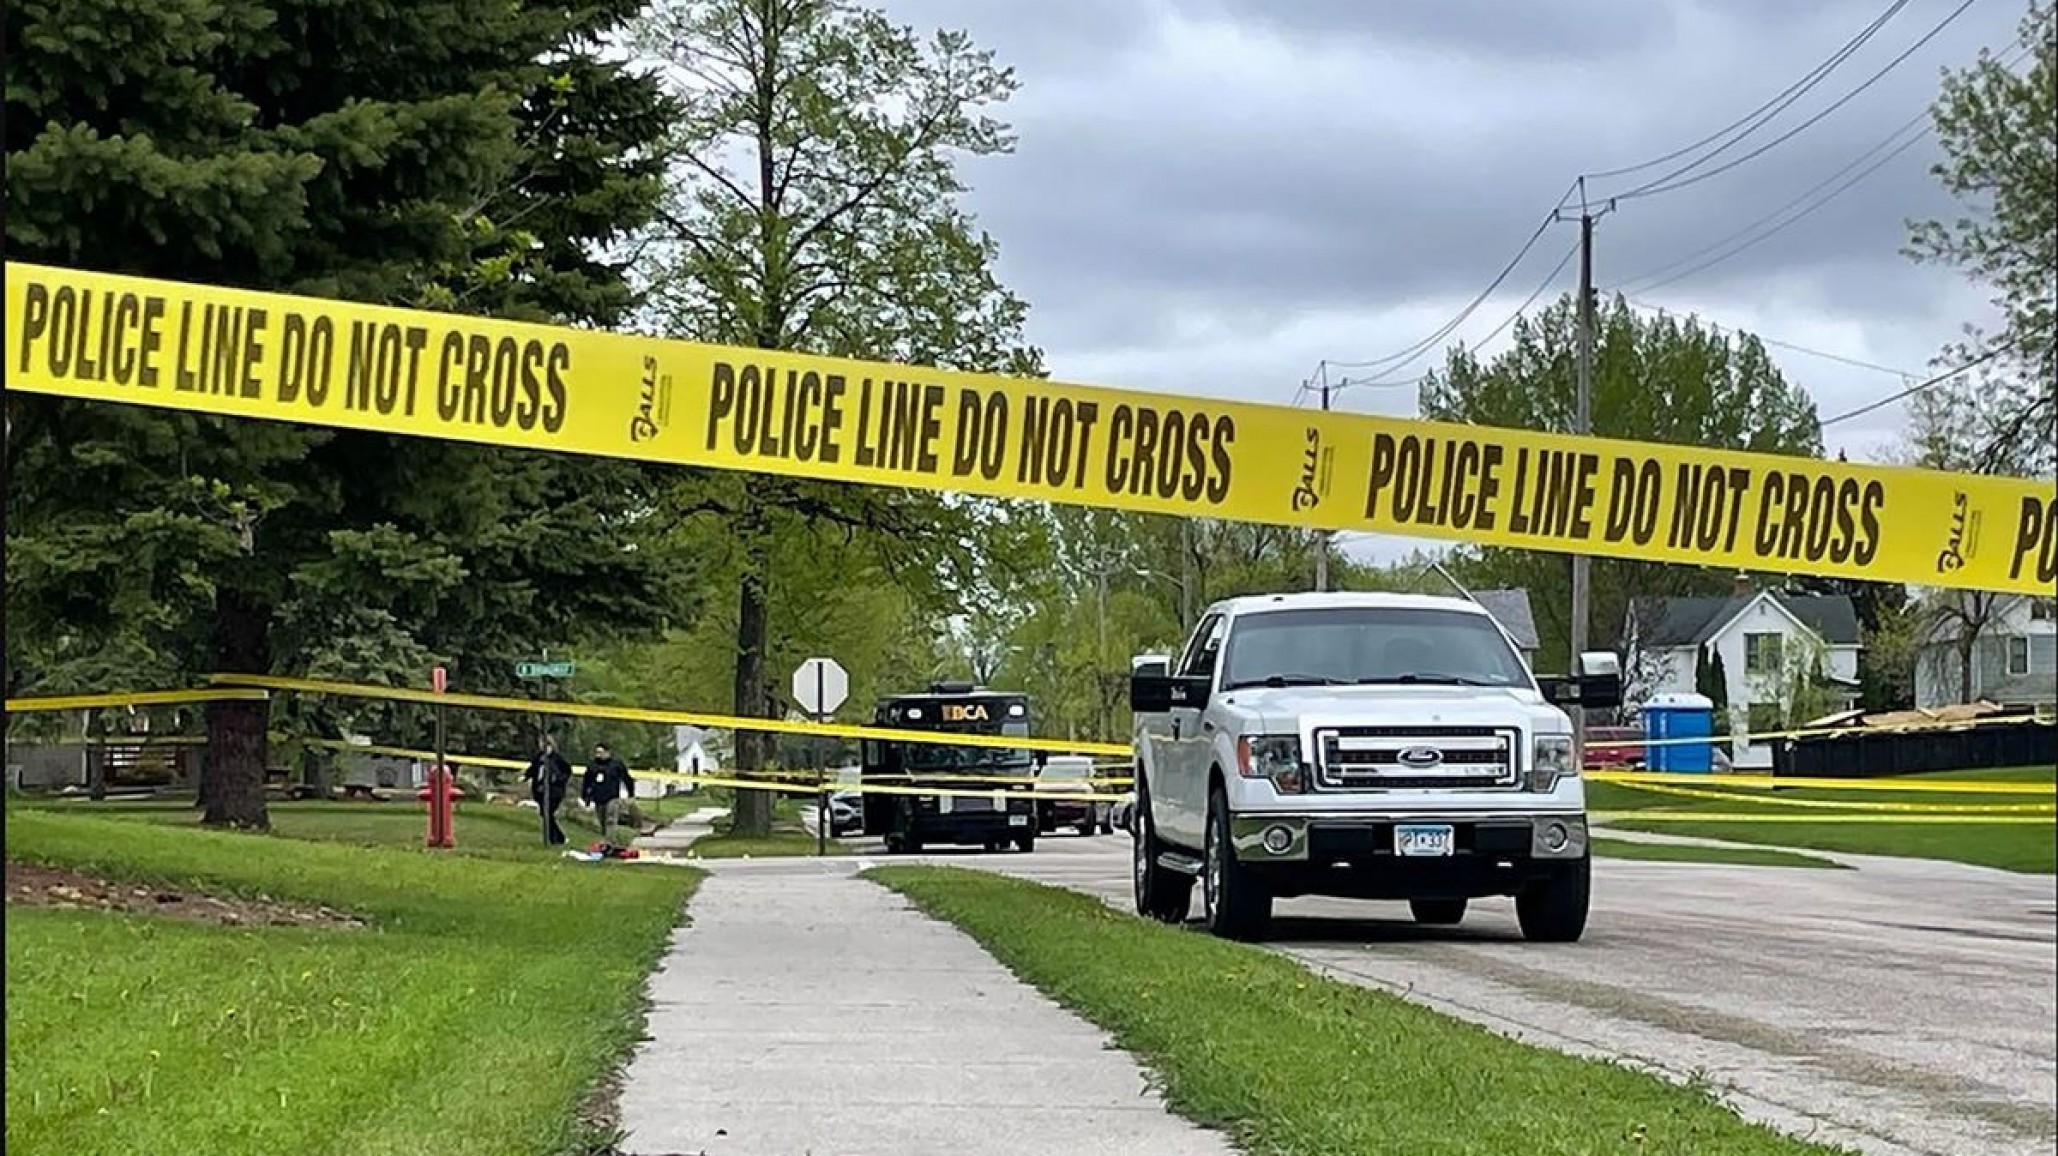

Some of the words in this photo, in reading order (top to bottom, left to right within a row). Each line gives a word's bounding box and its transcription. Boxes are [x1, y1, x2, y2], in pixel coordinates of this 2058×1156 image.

[20, 281, 165, 388] POLICE
[175, 300, 267, 400] LINE
[277, 313, 335, 408] DO
[345, 319, 429, 417] NOT
[438, 330, 569, 433] CROSS
[706, 361, 846, 465] POLICE
[854, 377, 942, 475] LINE
[952, 388, 1009, 486] DO
[1017, 395, 1099, 490] NOT
[1105, 404, 1236, 506] CROSS
[1364, 432, 1505, 532] POLICE
[1508, 446, 1600, 541] LINE
[1603, 456, 1663, 547] DO
[1667, 462, 1752, 551] NOT
[1754, 469, 1885, 568] CROSS
